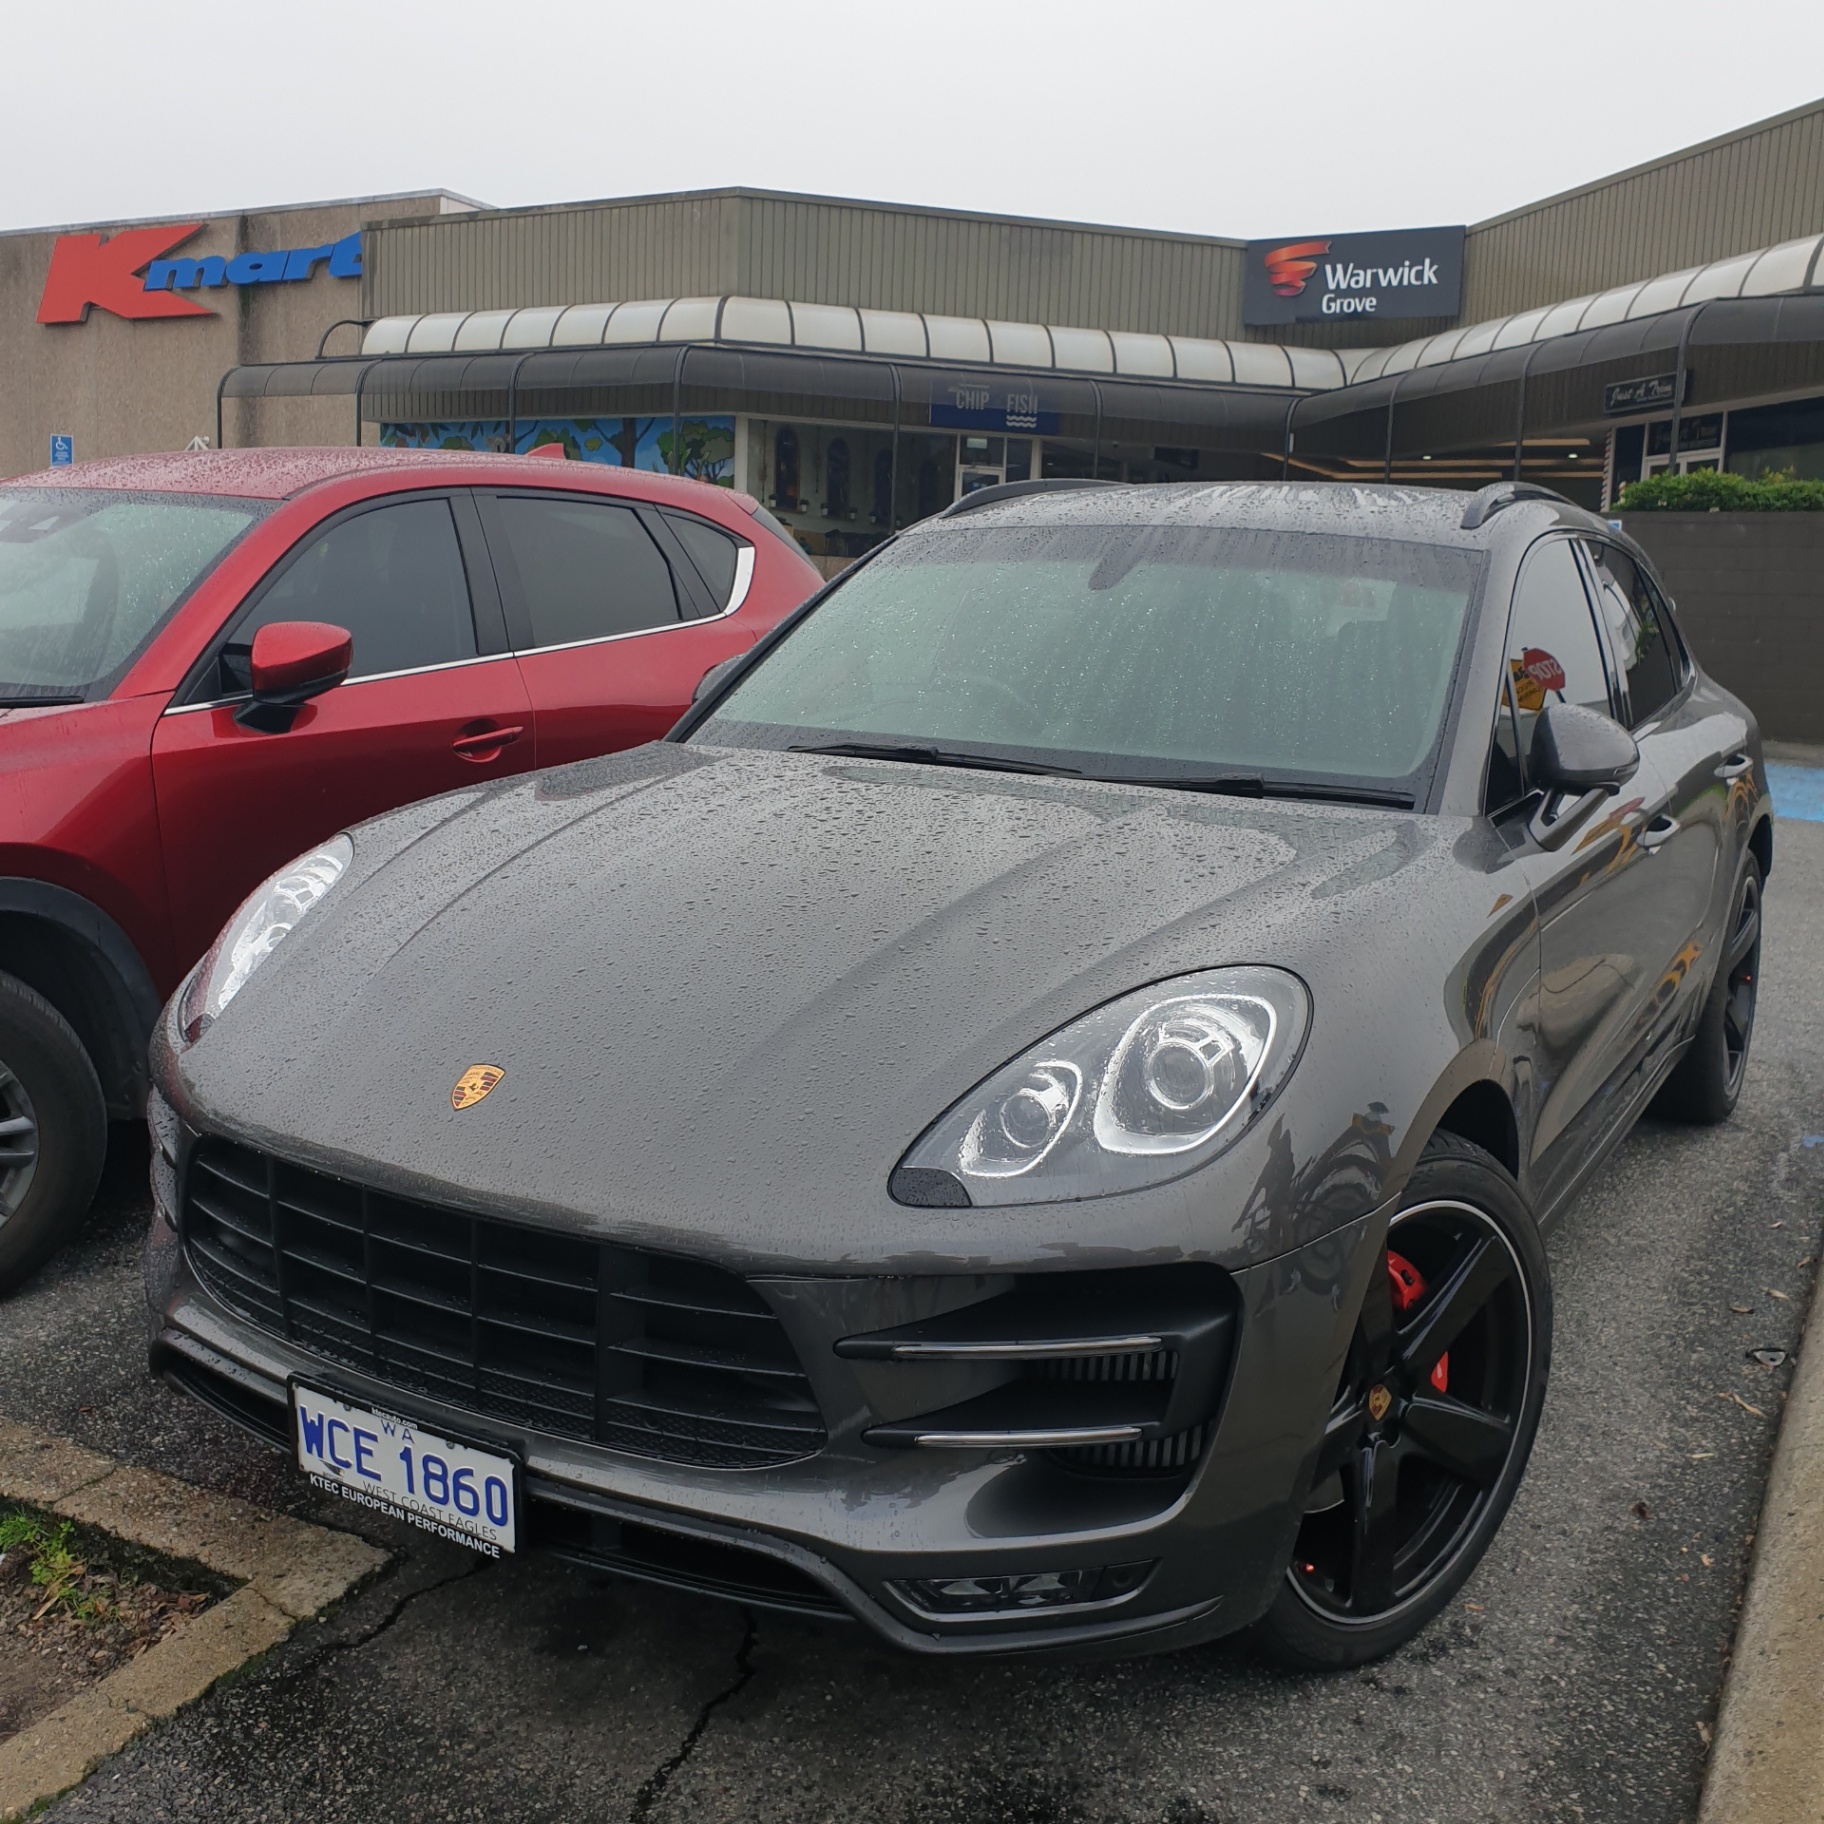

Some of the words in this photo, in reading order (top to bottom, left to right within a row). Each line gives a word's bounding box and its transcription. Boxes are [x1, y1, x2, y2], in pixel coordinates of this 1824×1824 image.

[1324, 257, 1439, 290] Warwick
[1321, 293, 1377, 314] Grove
[955, 389, 990, 411] CHIP
[1006, 393, 1039, 414] FISH
[299, 1403, 382, 1483] WCE
[399, 1445, 509, 1528] 1860
[309, 1473, 340, 1495] KTEC
[341, 1486, 405, 1521] EUROPEAN
[407, 1512, 501, 1559] PERFORMANCE
[362, 1480, 397, 1503] WEST
[401, 1496, 444, 1520] COAST
[448, 1513, 498, 1541] EAGLES
